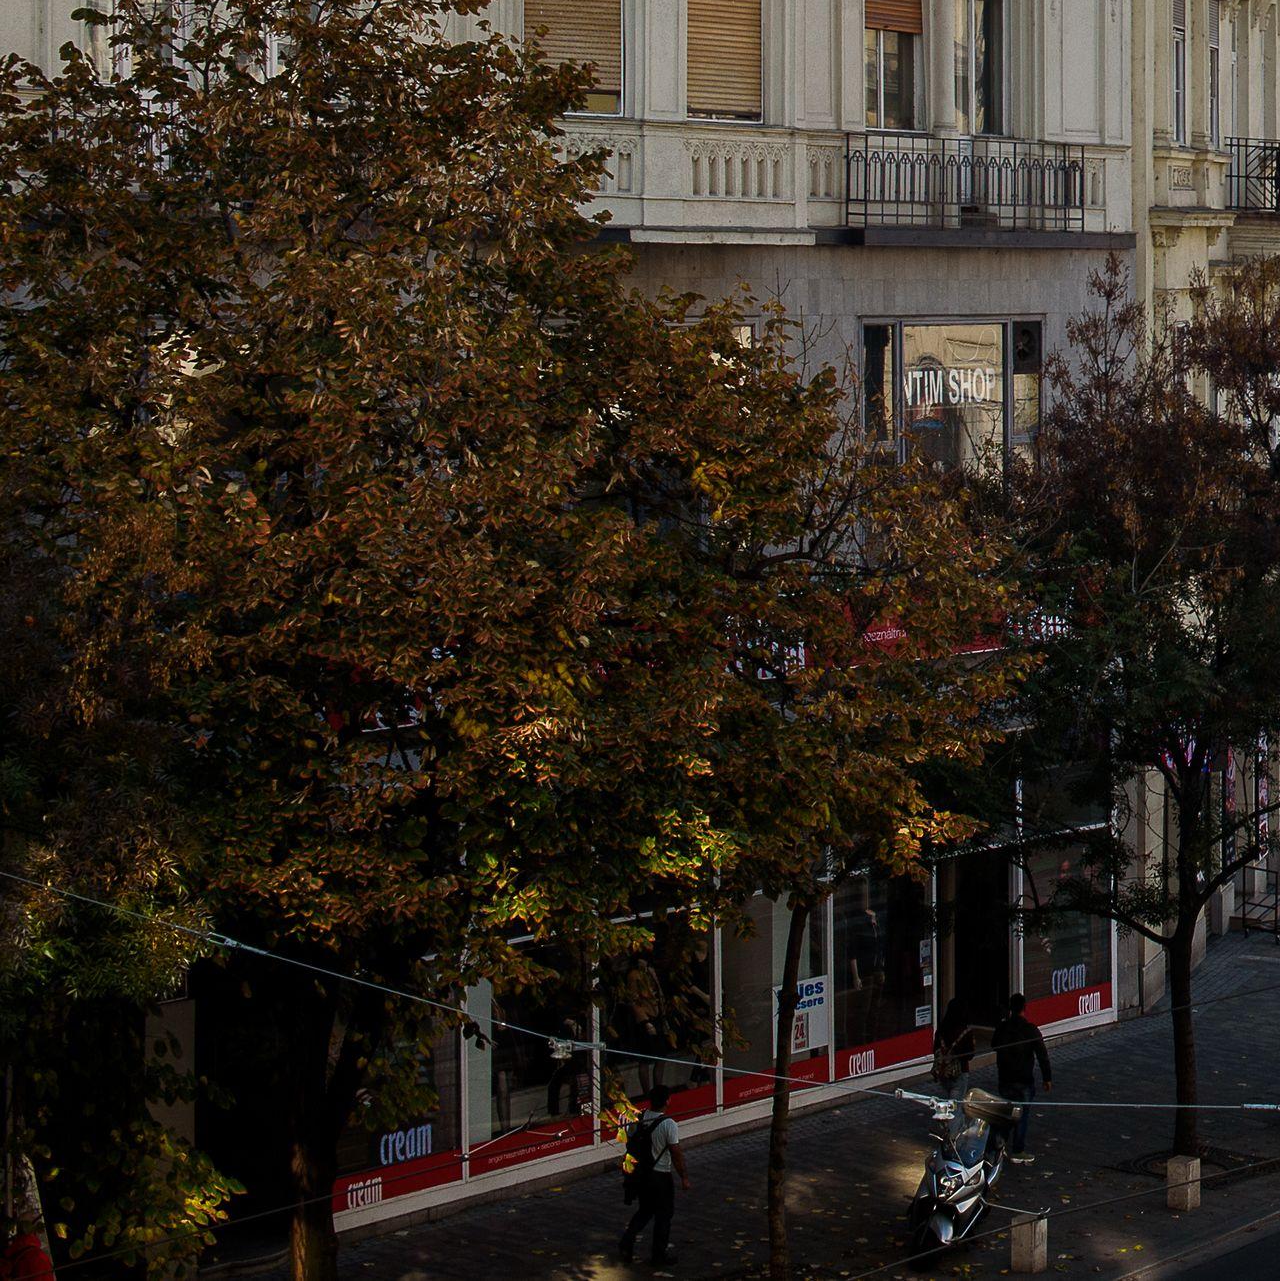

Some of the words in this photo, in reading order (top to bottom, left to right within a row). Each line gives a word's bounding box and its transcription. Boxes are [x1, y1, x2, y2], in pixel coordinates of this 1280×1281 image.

[1052, 963, 1086, 994] cream
[1078, 991, 1101, 1016] cream
[848, 1048, 876, 1076] cream
[379, 1123, 433, 1166] cream
[347, 1175, 383, 1211] cream
